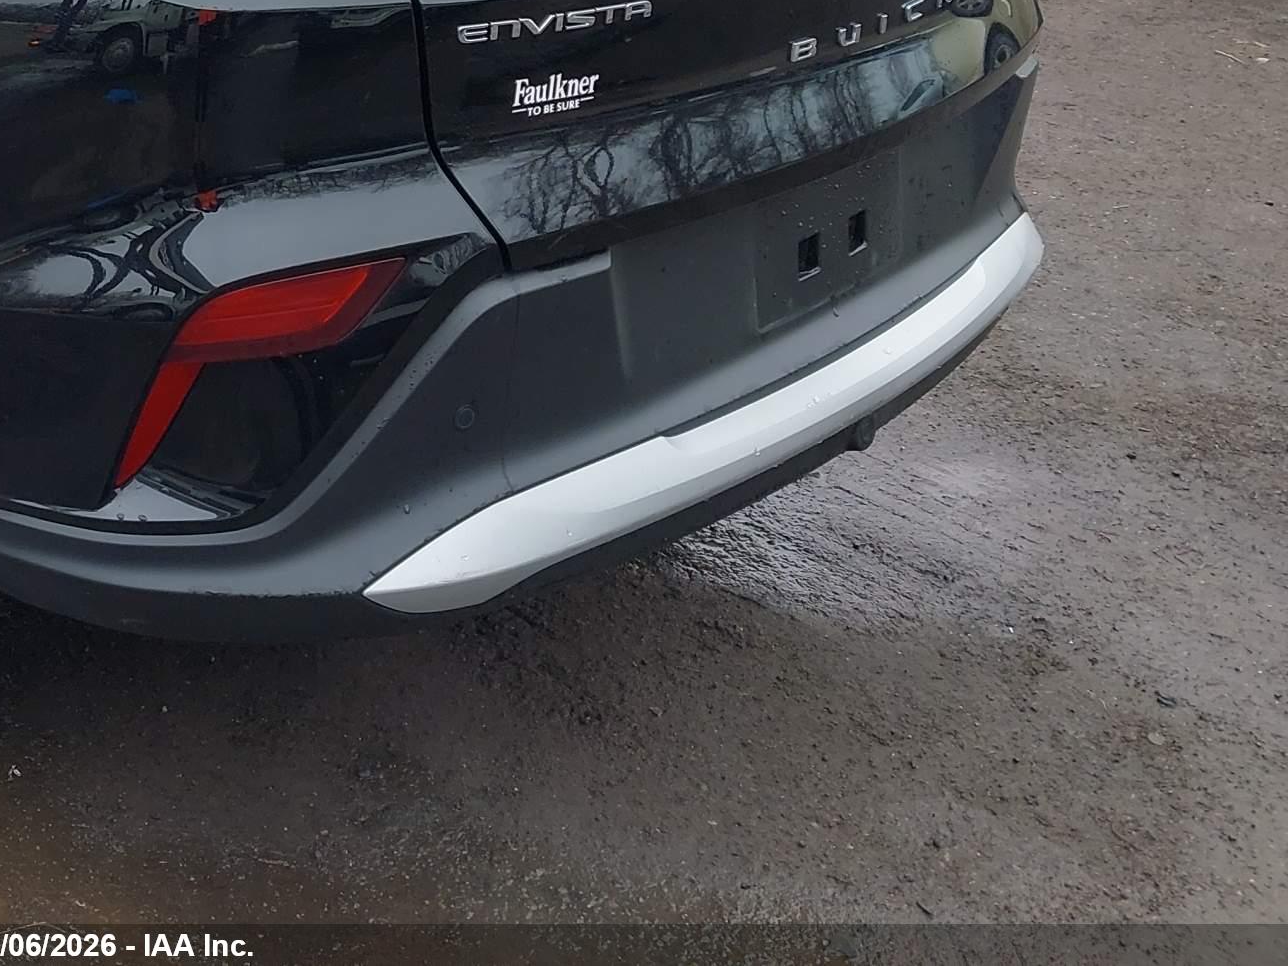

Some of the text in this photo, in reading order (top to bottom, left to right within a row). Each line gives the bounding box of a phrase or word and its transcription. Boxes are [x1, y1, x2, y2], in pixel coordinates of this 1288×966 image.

[457, 0, 653, 44] ENVISTA
[512, 73, 599, 107] Faulkner
[528, 99, 580, 117] TO BE SURE
